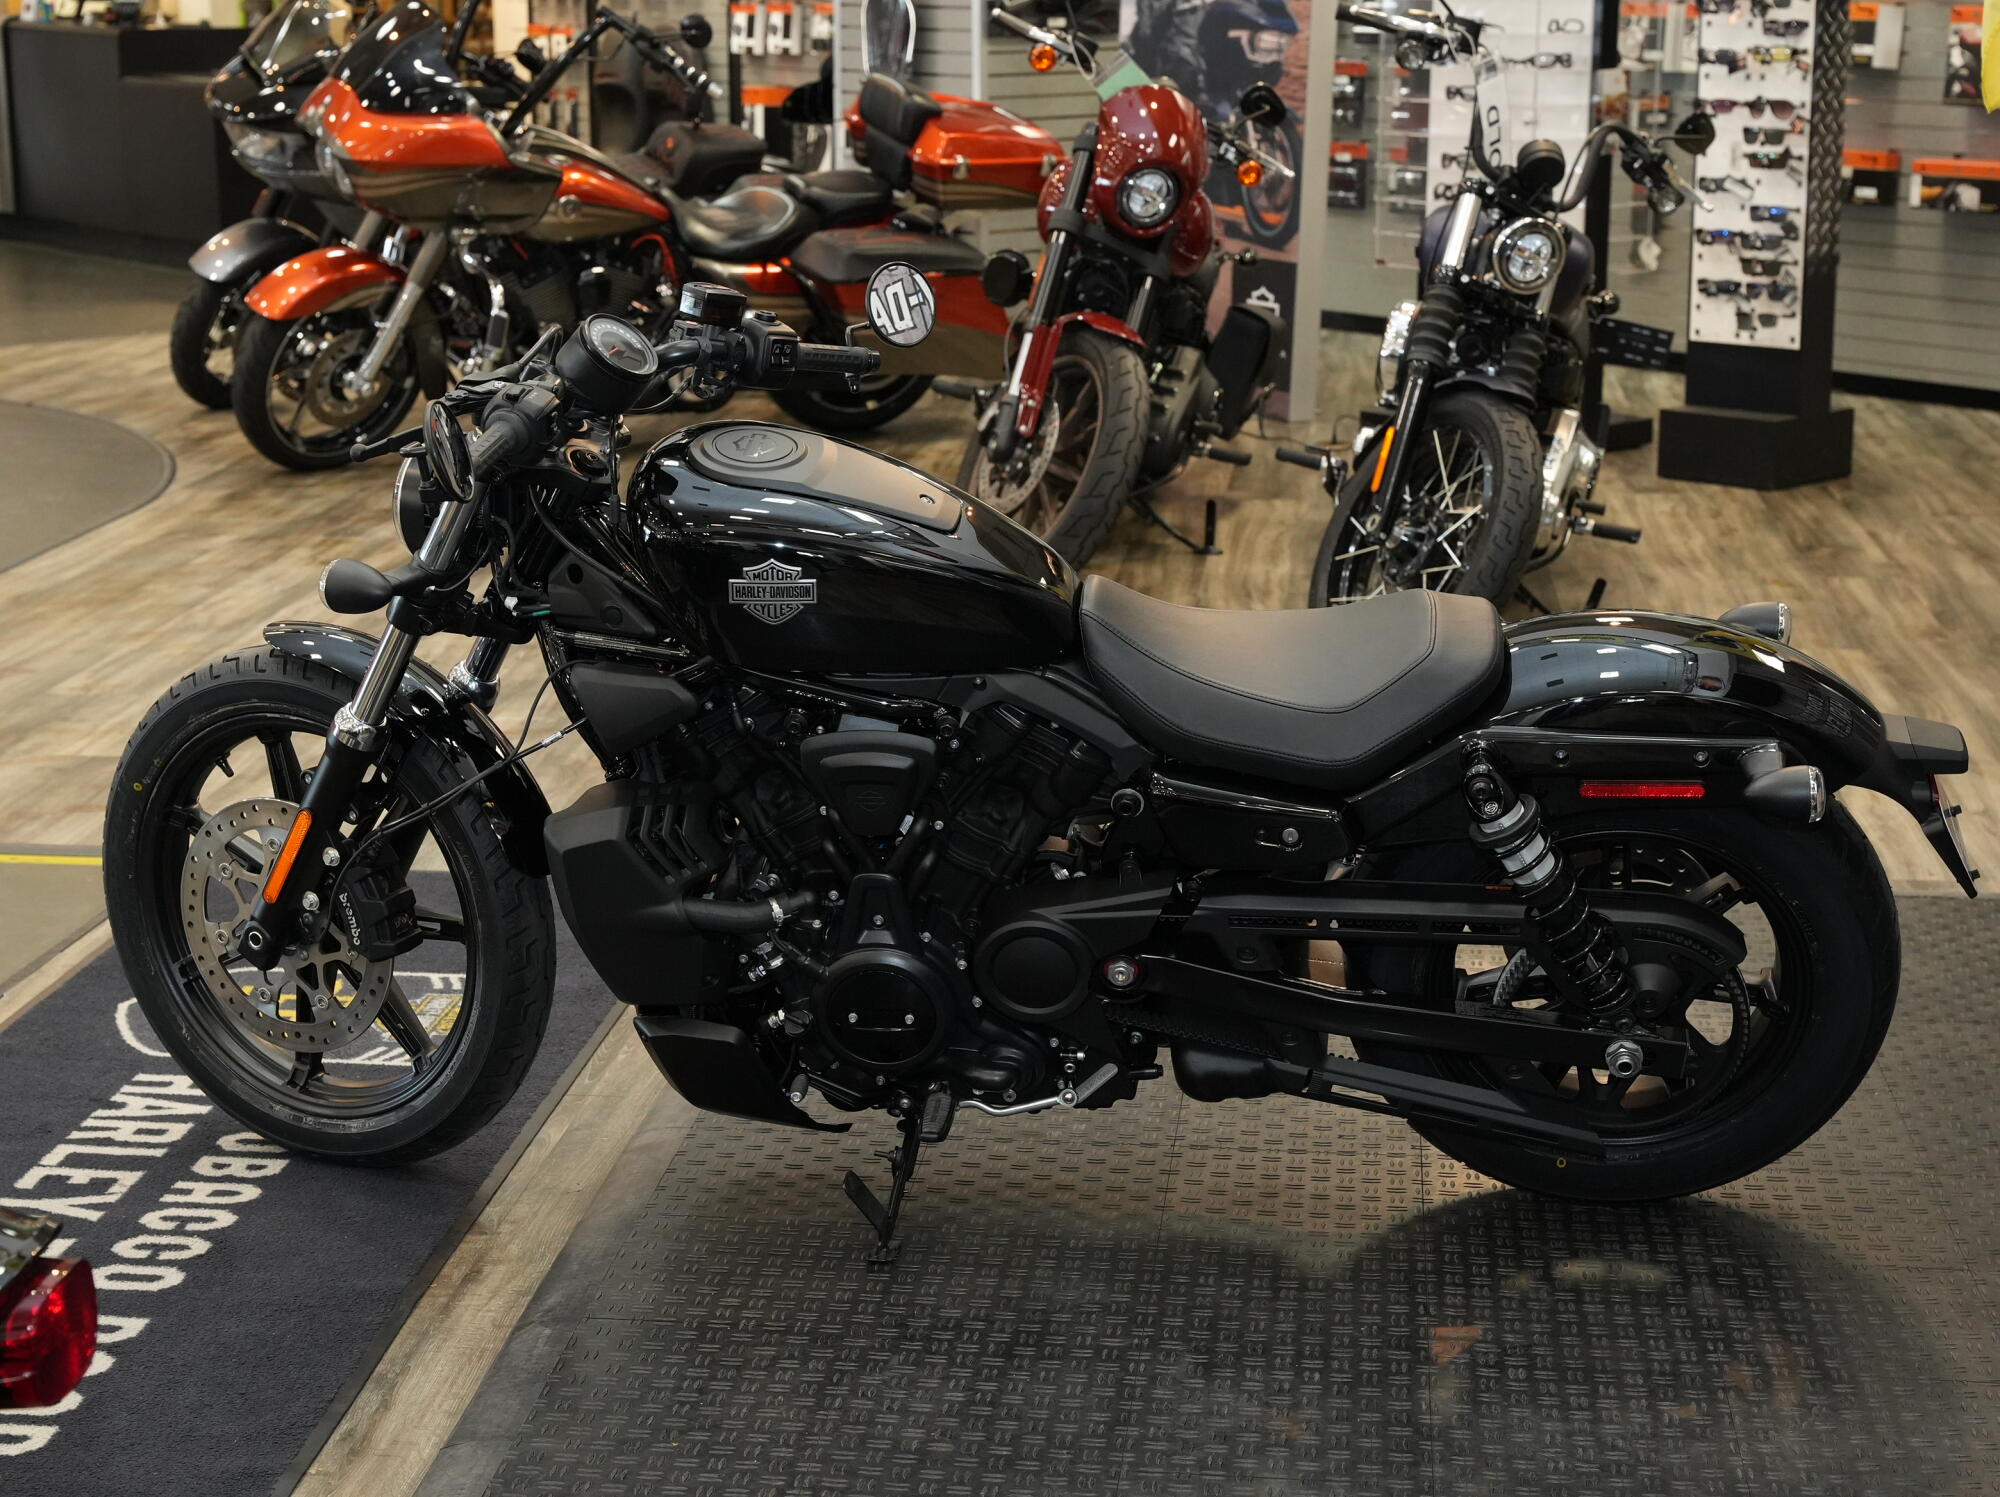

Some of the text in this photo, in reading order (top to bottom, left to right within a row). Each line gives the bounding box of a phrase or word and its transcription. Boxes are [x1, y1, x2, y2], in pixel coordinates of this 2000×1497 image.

[1486, 105, 1502, 168] OLD
[752, 566, 794, 581] MOTOR
[734, 585, 812, 599] HARLEY-DAVIDSON
[753, 603, 795, 619] CYCLES
[338, 892, 361, 946] brembo
